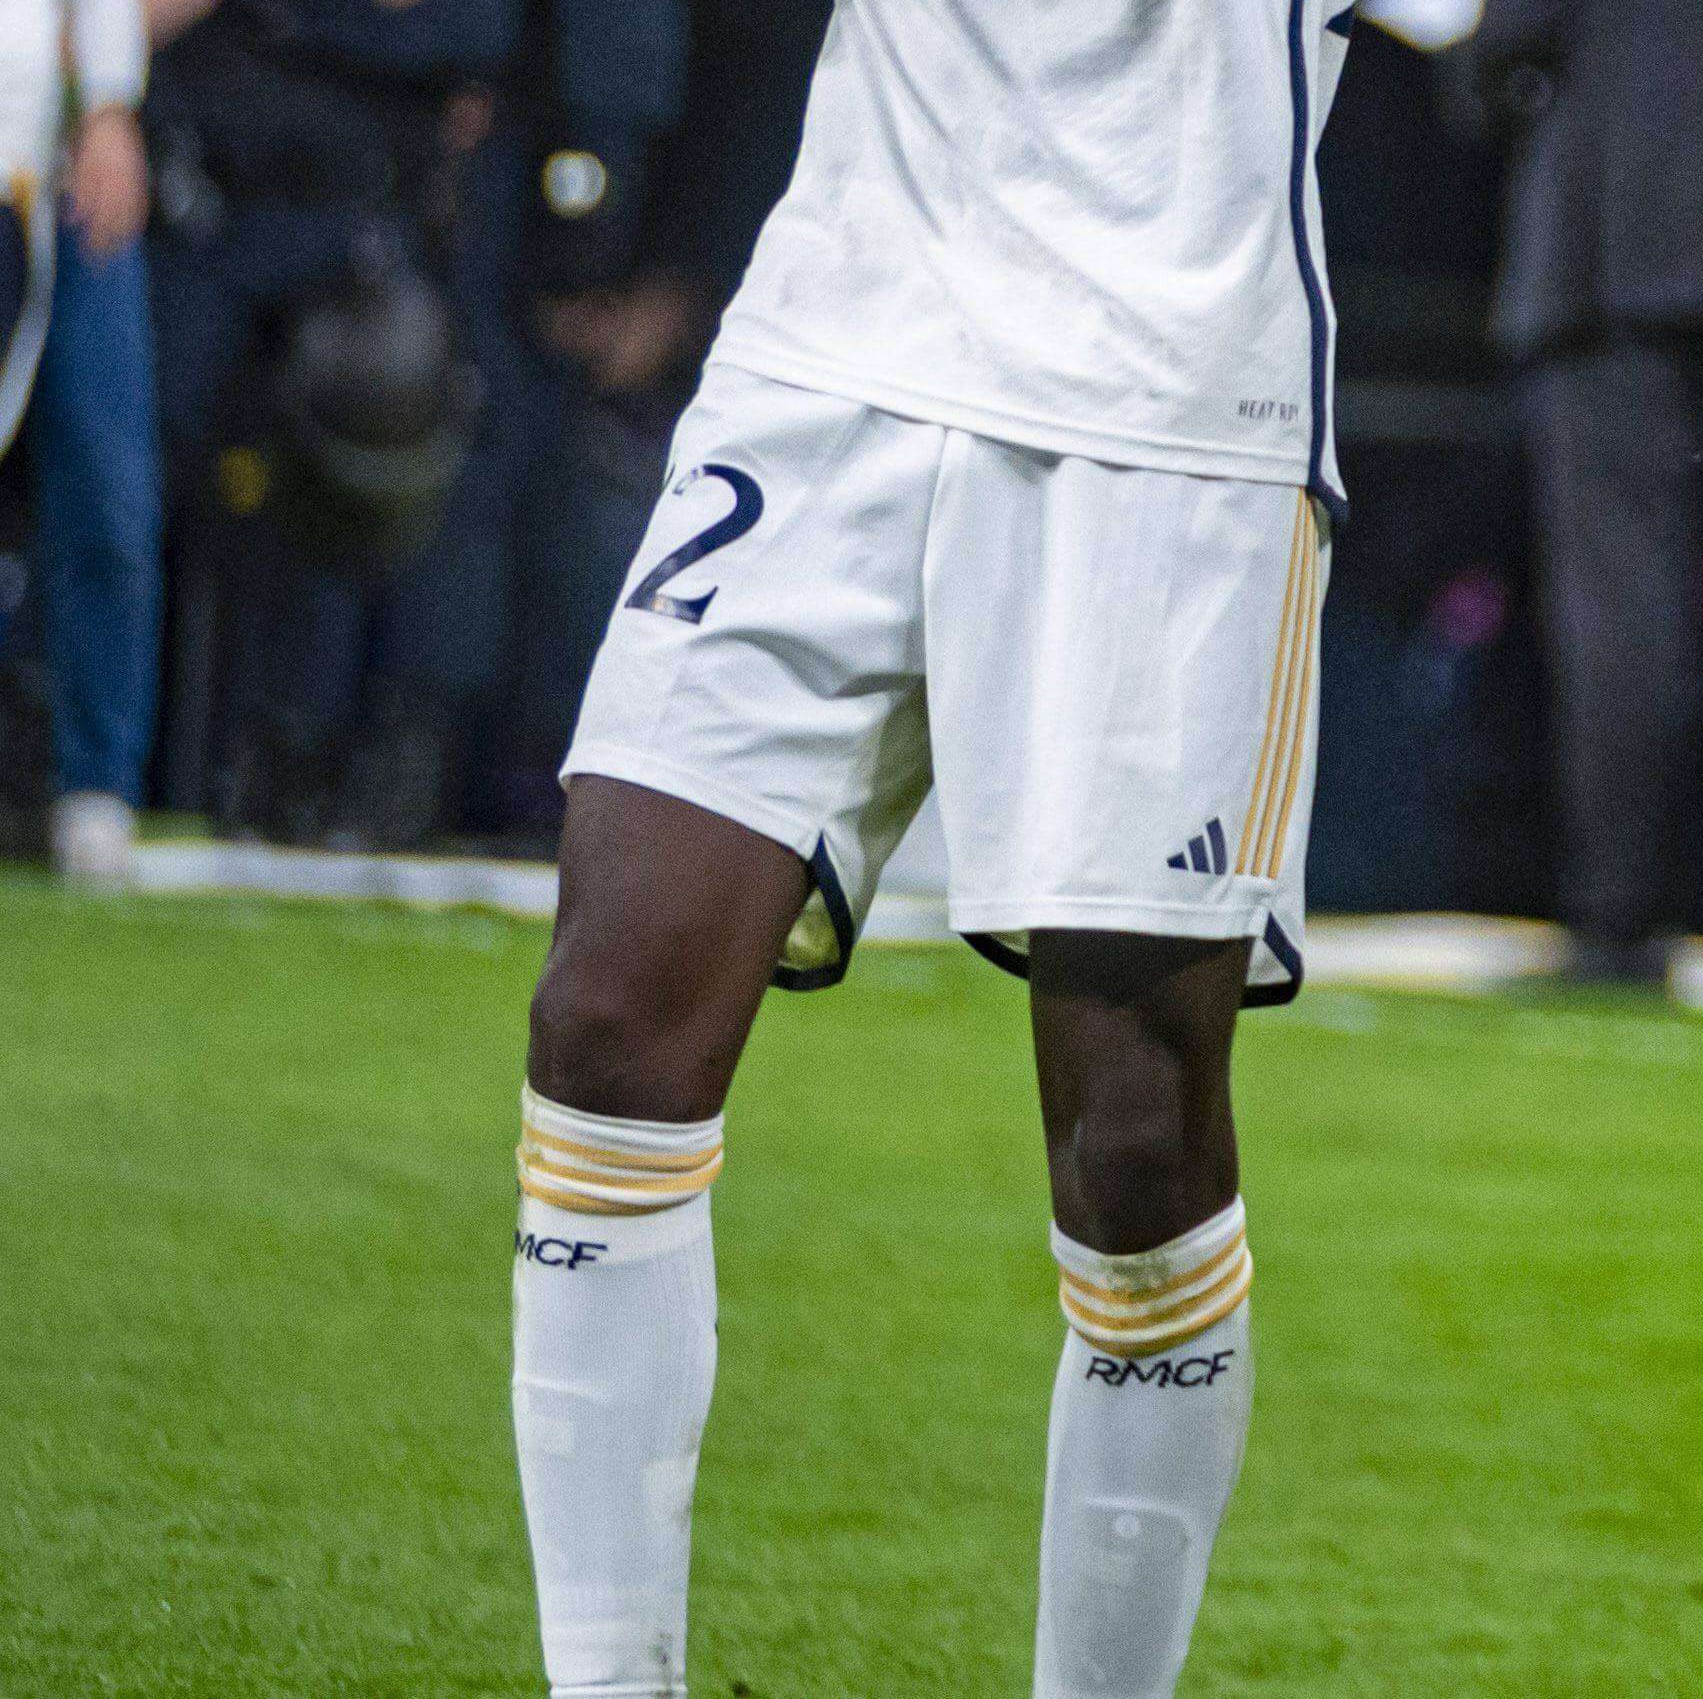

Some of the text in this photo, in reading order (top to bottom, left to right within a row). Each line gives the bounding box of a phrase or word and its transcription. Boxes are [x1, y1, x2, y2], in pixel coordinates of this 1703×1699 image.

[623, 463, 765, 626] 2
[513, 1229, 608, 1271] MCF
[1085, 1348, 1235, 1389] RMCF
